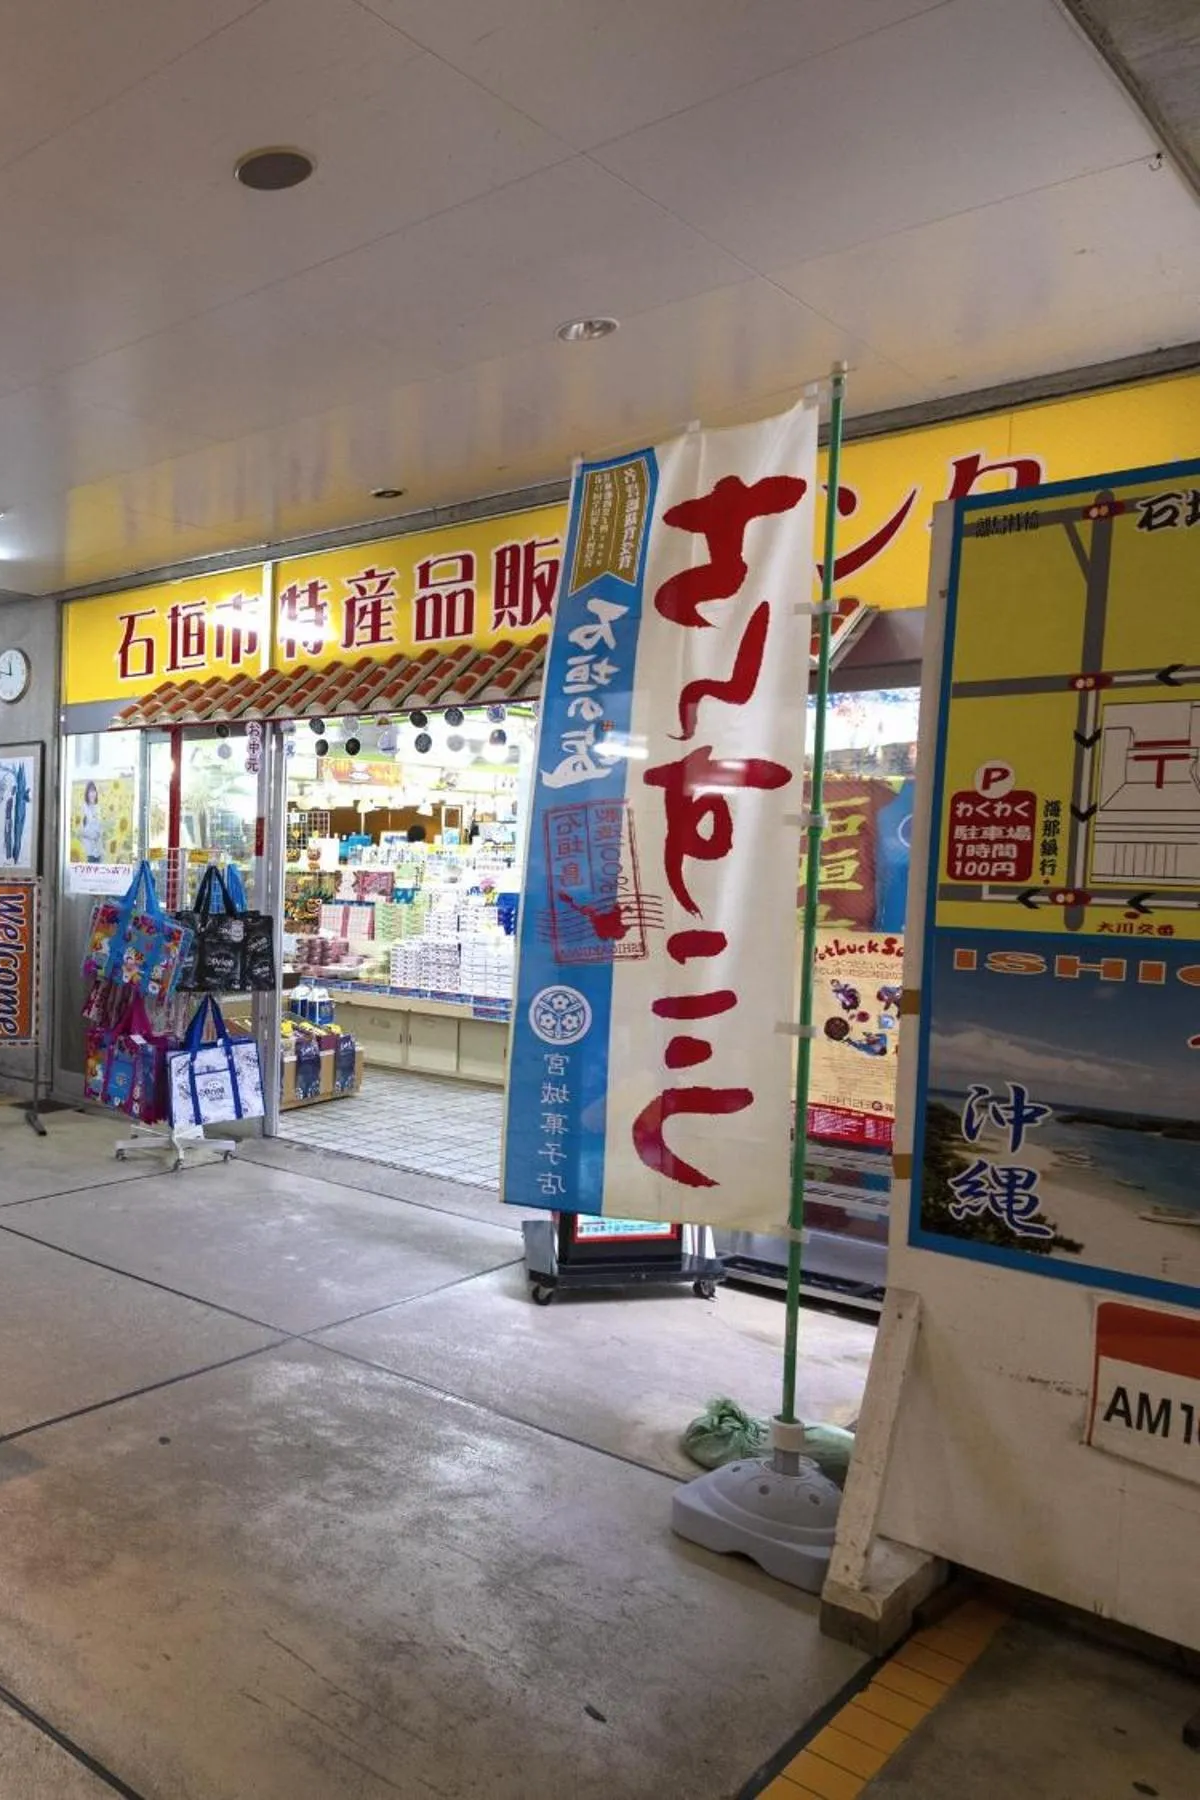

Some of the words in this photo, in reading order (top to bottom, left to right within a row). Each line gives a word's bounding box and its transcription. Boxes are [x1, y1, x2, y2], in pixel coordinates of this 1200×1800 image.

[1137, 488, 1200, 531] 石
[118, 537, 561, 680] 石垣市特産品販
[247, 722, 260, 773] お中元
[981, 767, 1010, 791] P
[955, 801, 1030, 818] わくわく
[953, 825, 1031, 841] 駐車場
[1039, 800, 1062, 877] 海邦銀行
[955, 844, 1017, 860] 1時間
[955, 862, 1016, 877] 100円
[1097, 921, 1175, 936] 大川交番
[948, 1082, 1054, 1240] 沖縄
[1103, 1385, 1200, 1446] AM1
